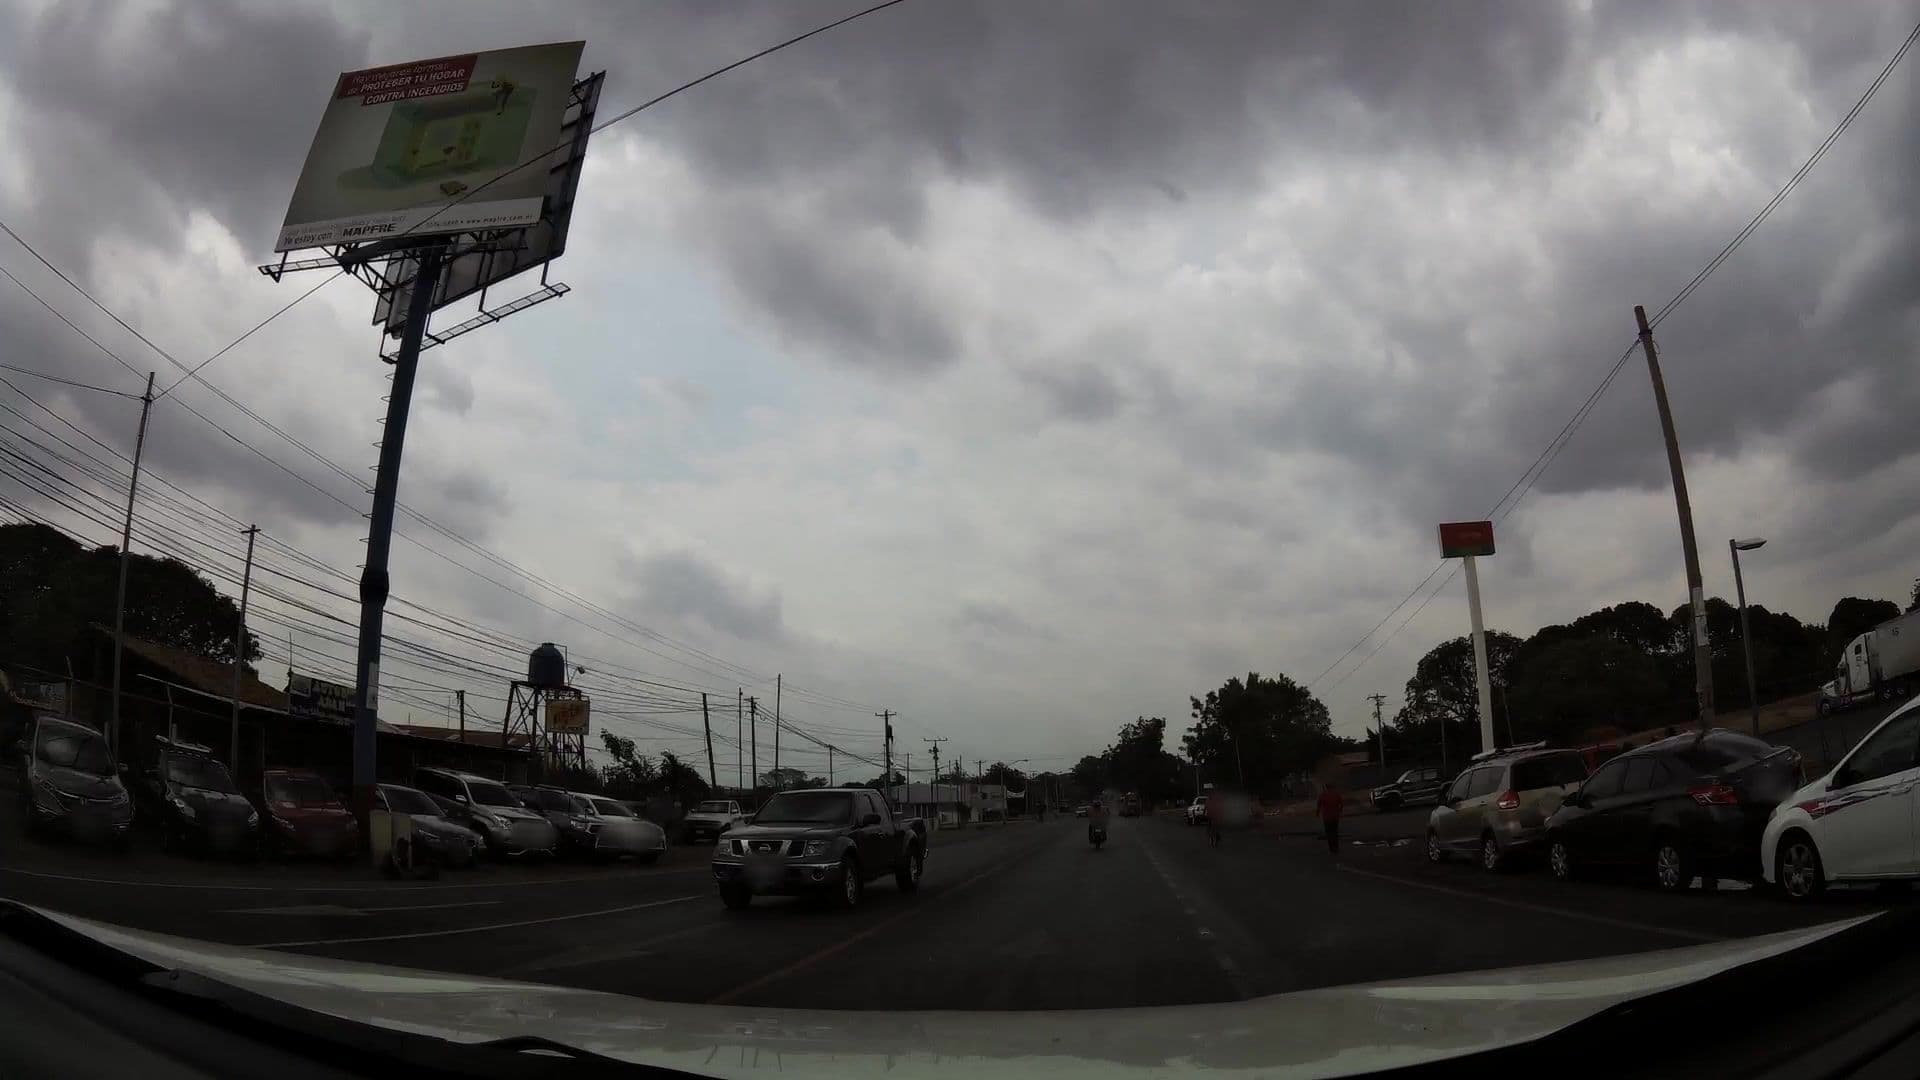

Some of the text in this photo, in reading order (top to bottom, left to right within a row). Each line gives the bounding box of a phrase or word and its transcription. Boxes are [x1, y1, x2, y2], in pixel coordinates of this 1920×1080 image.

[360, 76, 411, 93] PROTEGER
[413, 74, 428, 84] TU
[430, 69, 465, 81] HOGAR
[366, 83, 464, 105] CONTRA INCENDIOS
[343, 222, 397, 237] MAPFRE
